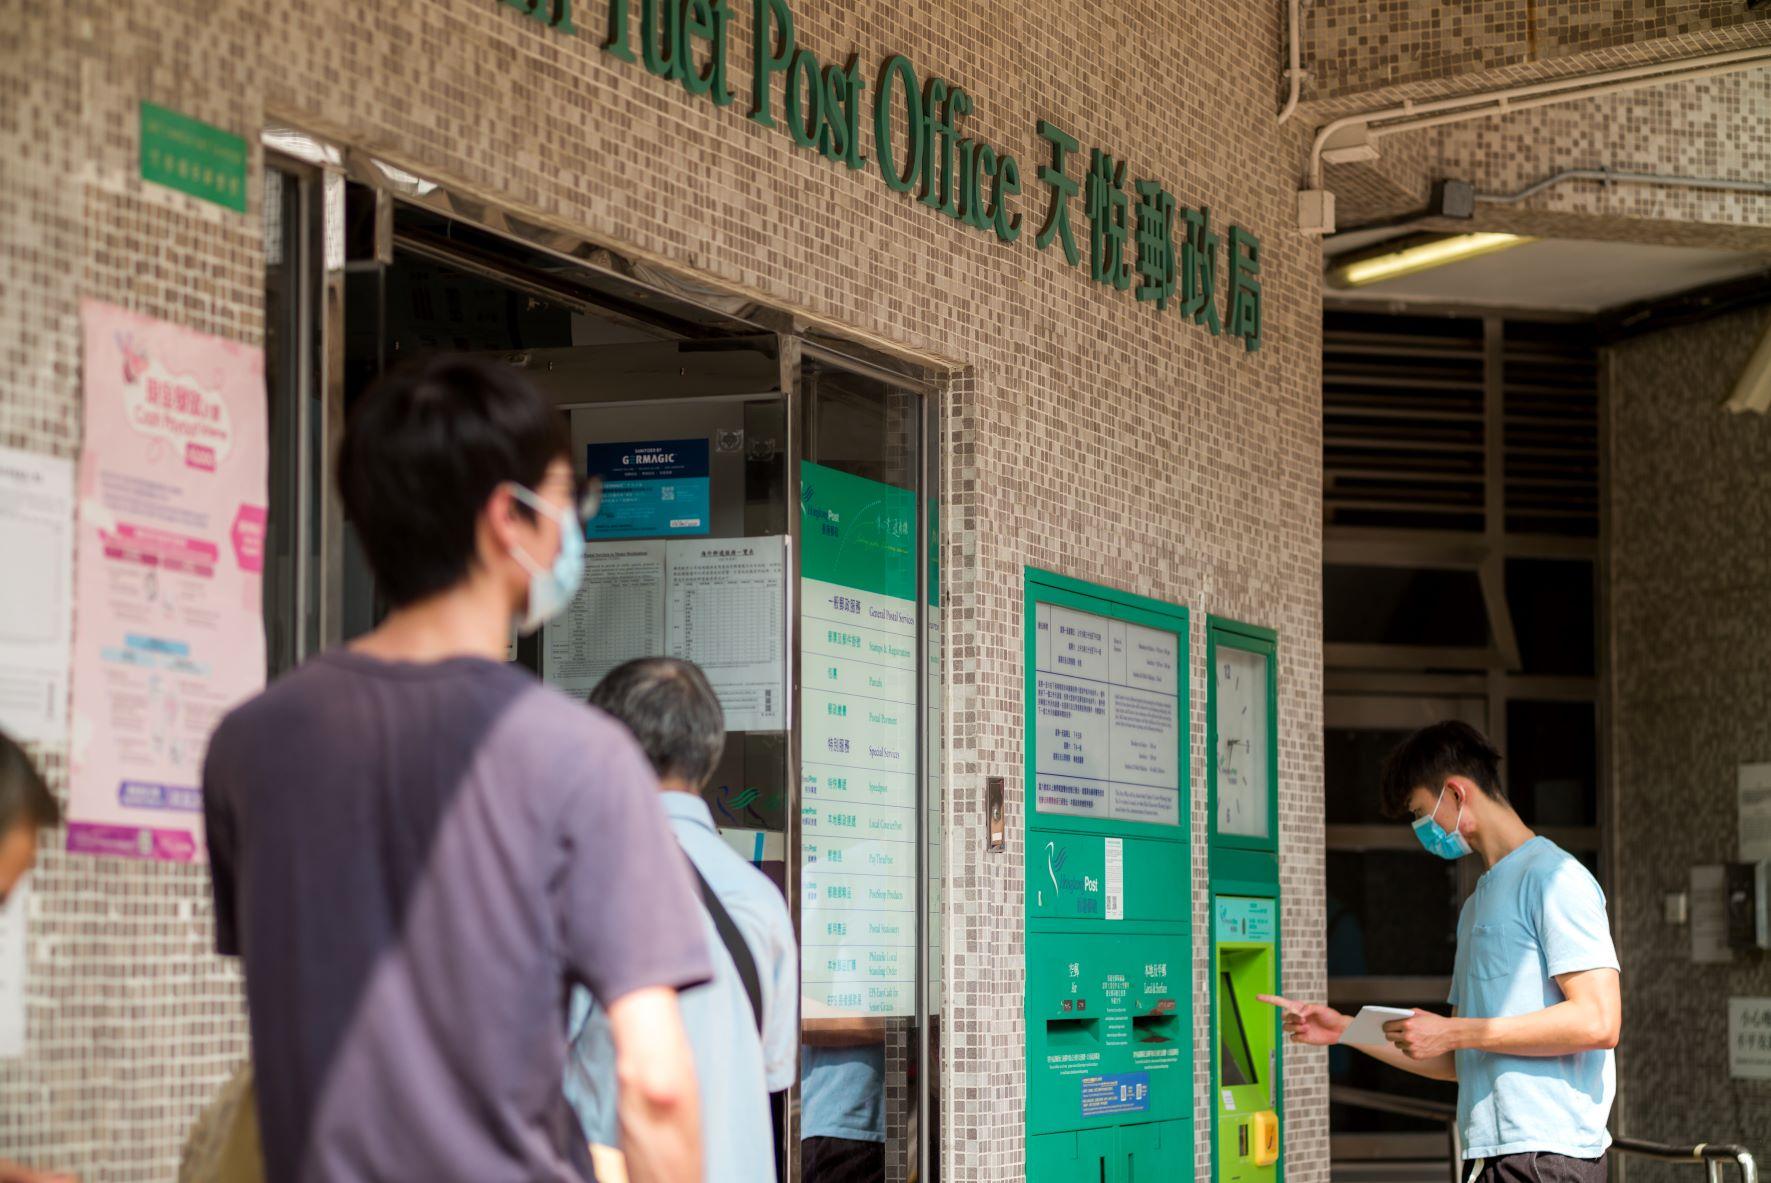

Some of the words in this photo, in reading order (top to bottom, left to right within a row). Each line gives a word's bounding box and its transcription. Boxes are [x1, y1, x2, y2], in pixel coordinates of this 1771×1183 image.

[751, 0, 866, 170] Post
[874, 54, 1023, 242] Office
[1036, 119, 1262, 351] 天悅郵政局
[869, 606, 885, 619] General
[886, 610, 898, 622] Postal
[899, 613, 915, 626] Services
[869, 745, 883, 759] Special
[884, 747, 900, 760] Services
[1084, 877, 1098, 894] Post
